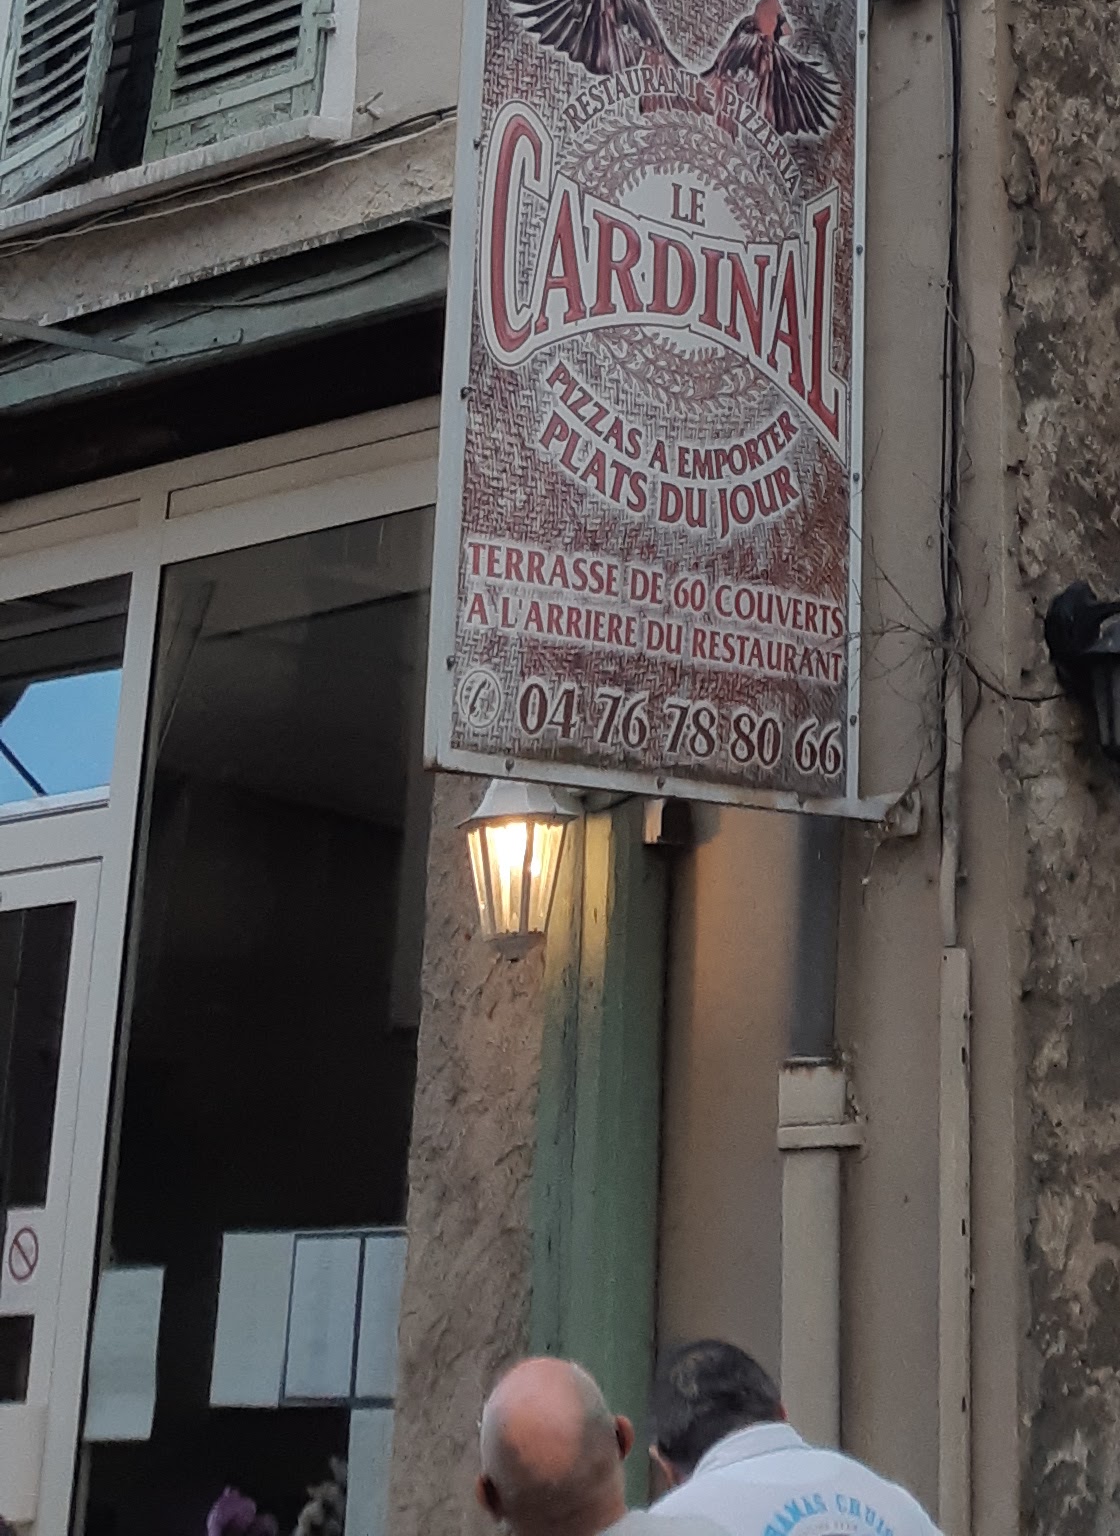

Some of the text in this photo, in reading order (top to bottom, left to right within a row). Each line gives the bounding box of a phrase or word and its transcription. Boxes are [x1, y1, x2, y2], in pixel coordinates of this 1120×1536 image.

[562, 68, 699, 133] RESTAURANT
[721, 86, 801, 195] PIZZERIA
[671, 183, 706, 227] LE
[487, 111, 843, 442] CARDINAL
[546, 360, 800, 480] PIZZAS A EMPORTER
[539, 410, 801, 539] PLATS DU JOUR
[467, 593, 843, 682] A L'ARRIERE DU RESTAURANT
[468, 543, 844, 638] TERRASSE DE 60 COUVERTS
[519, 682, 842, 776] 04 76 78 80 66
